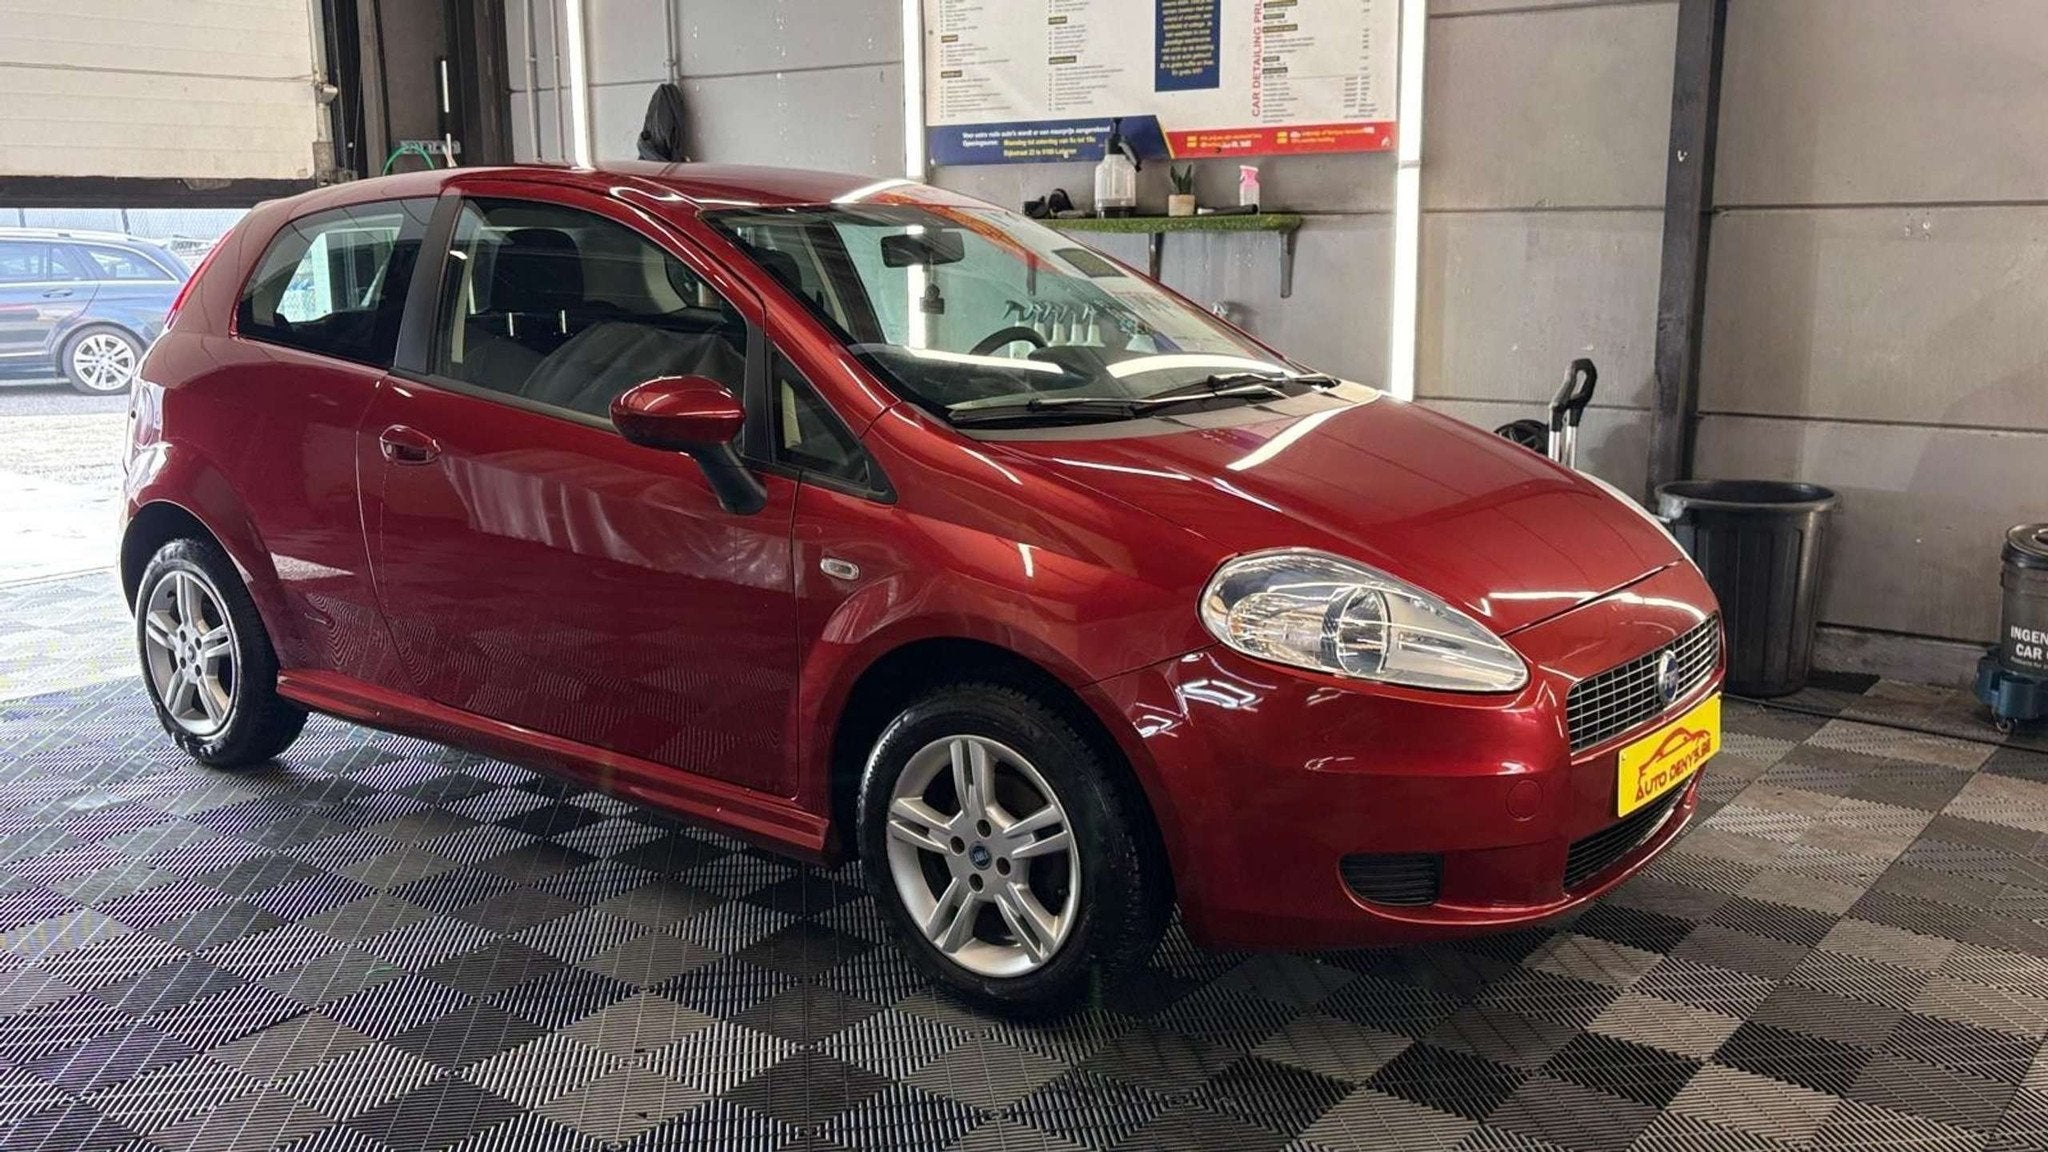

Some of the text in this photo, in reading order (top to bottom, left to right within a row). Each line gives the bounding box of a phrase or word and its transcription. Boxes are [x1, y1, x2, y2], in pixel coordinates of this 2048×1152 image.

[1252, 0, 1261, 117] CAR DETAILING PRI
[2016, 643, 2042, 660] CAR
[1635, 771, 1668, 803] AUTO
